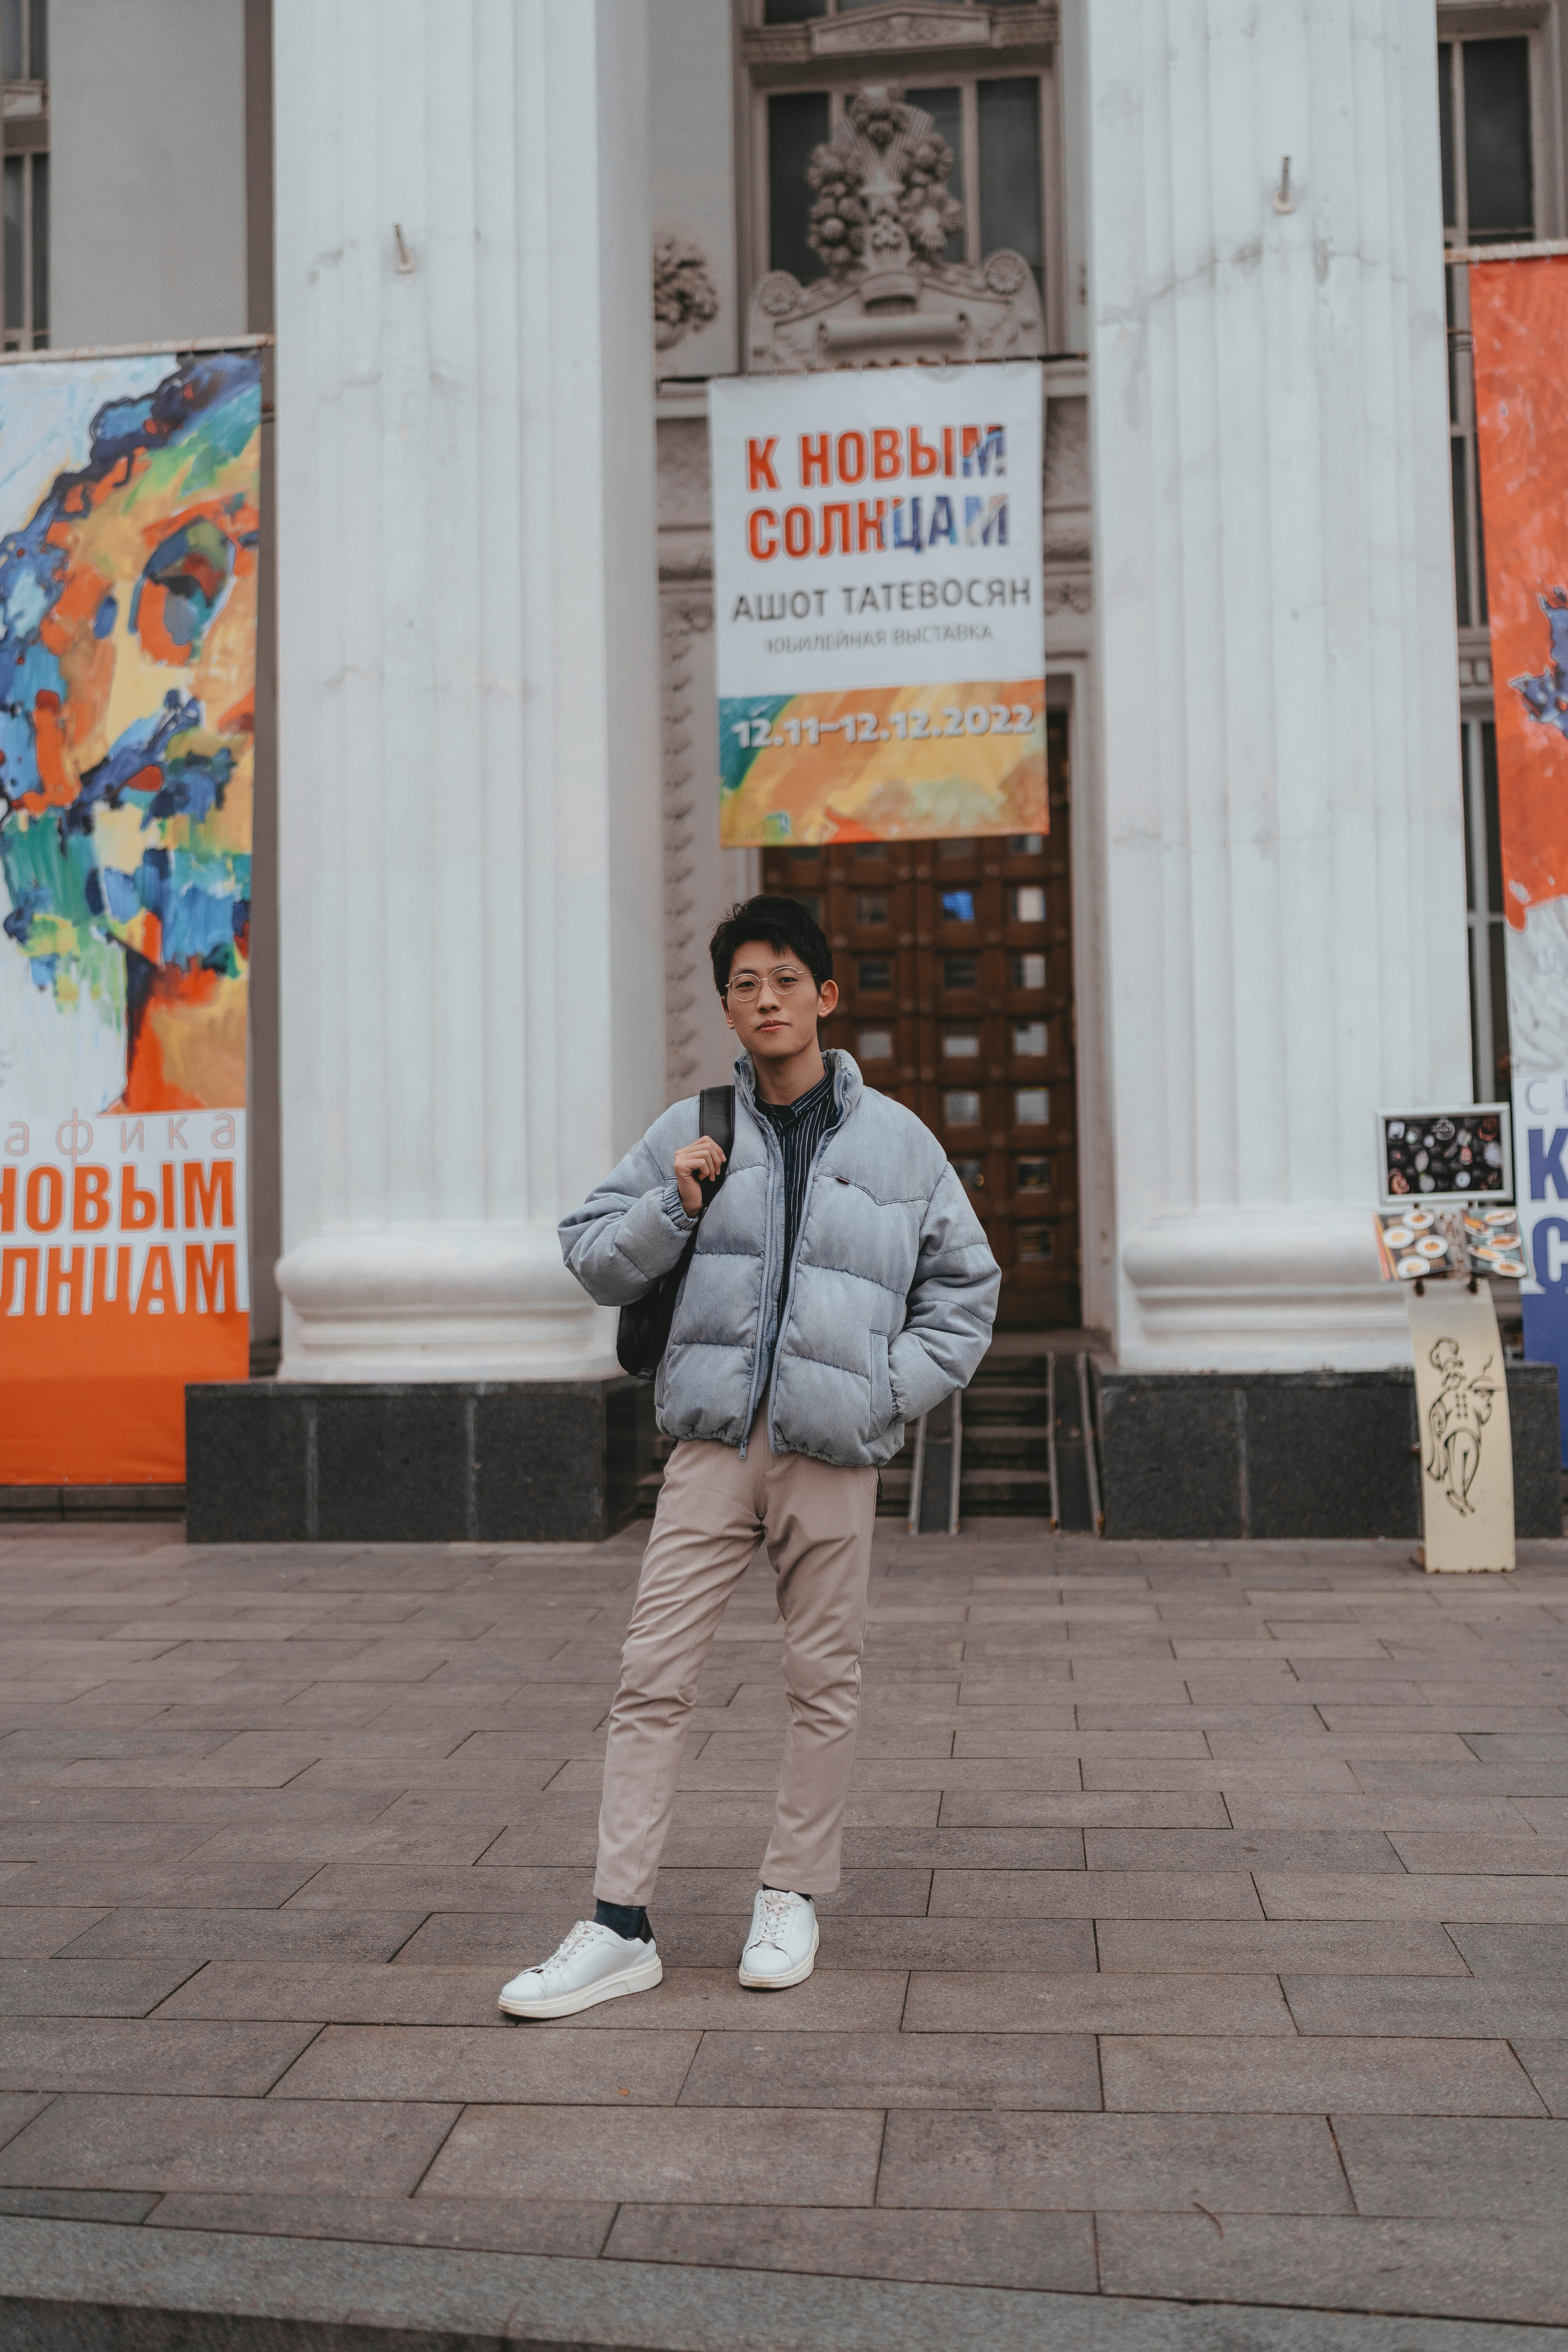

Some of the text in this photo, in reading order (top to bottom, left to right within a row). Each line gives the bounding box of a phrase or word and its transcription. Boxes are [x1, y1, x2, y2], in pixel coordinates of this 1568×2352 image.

[748, 425, 1007, 491] К НОВЫМ
[748, 495, 1010, 562] СОЛНЦАМ
[734, 578, 1032, 622] АШОТ ТАТЕВОСЯН
[767, 622, 995, 654] ЮБИЛЕЙНАЯ ВЫСТАВКА
